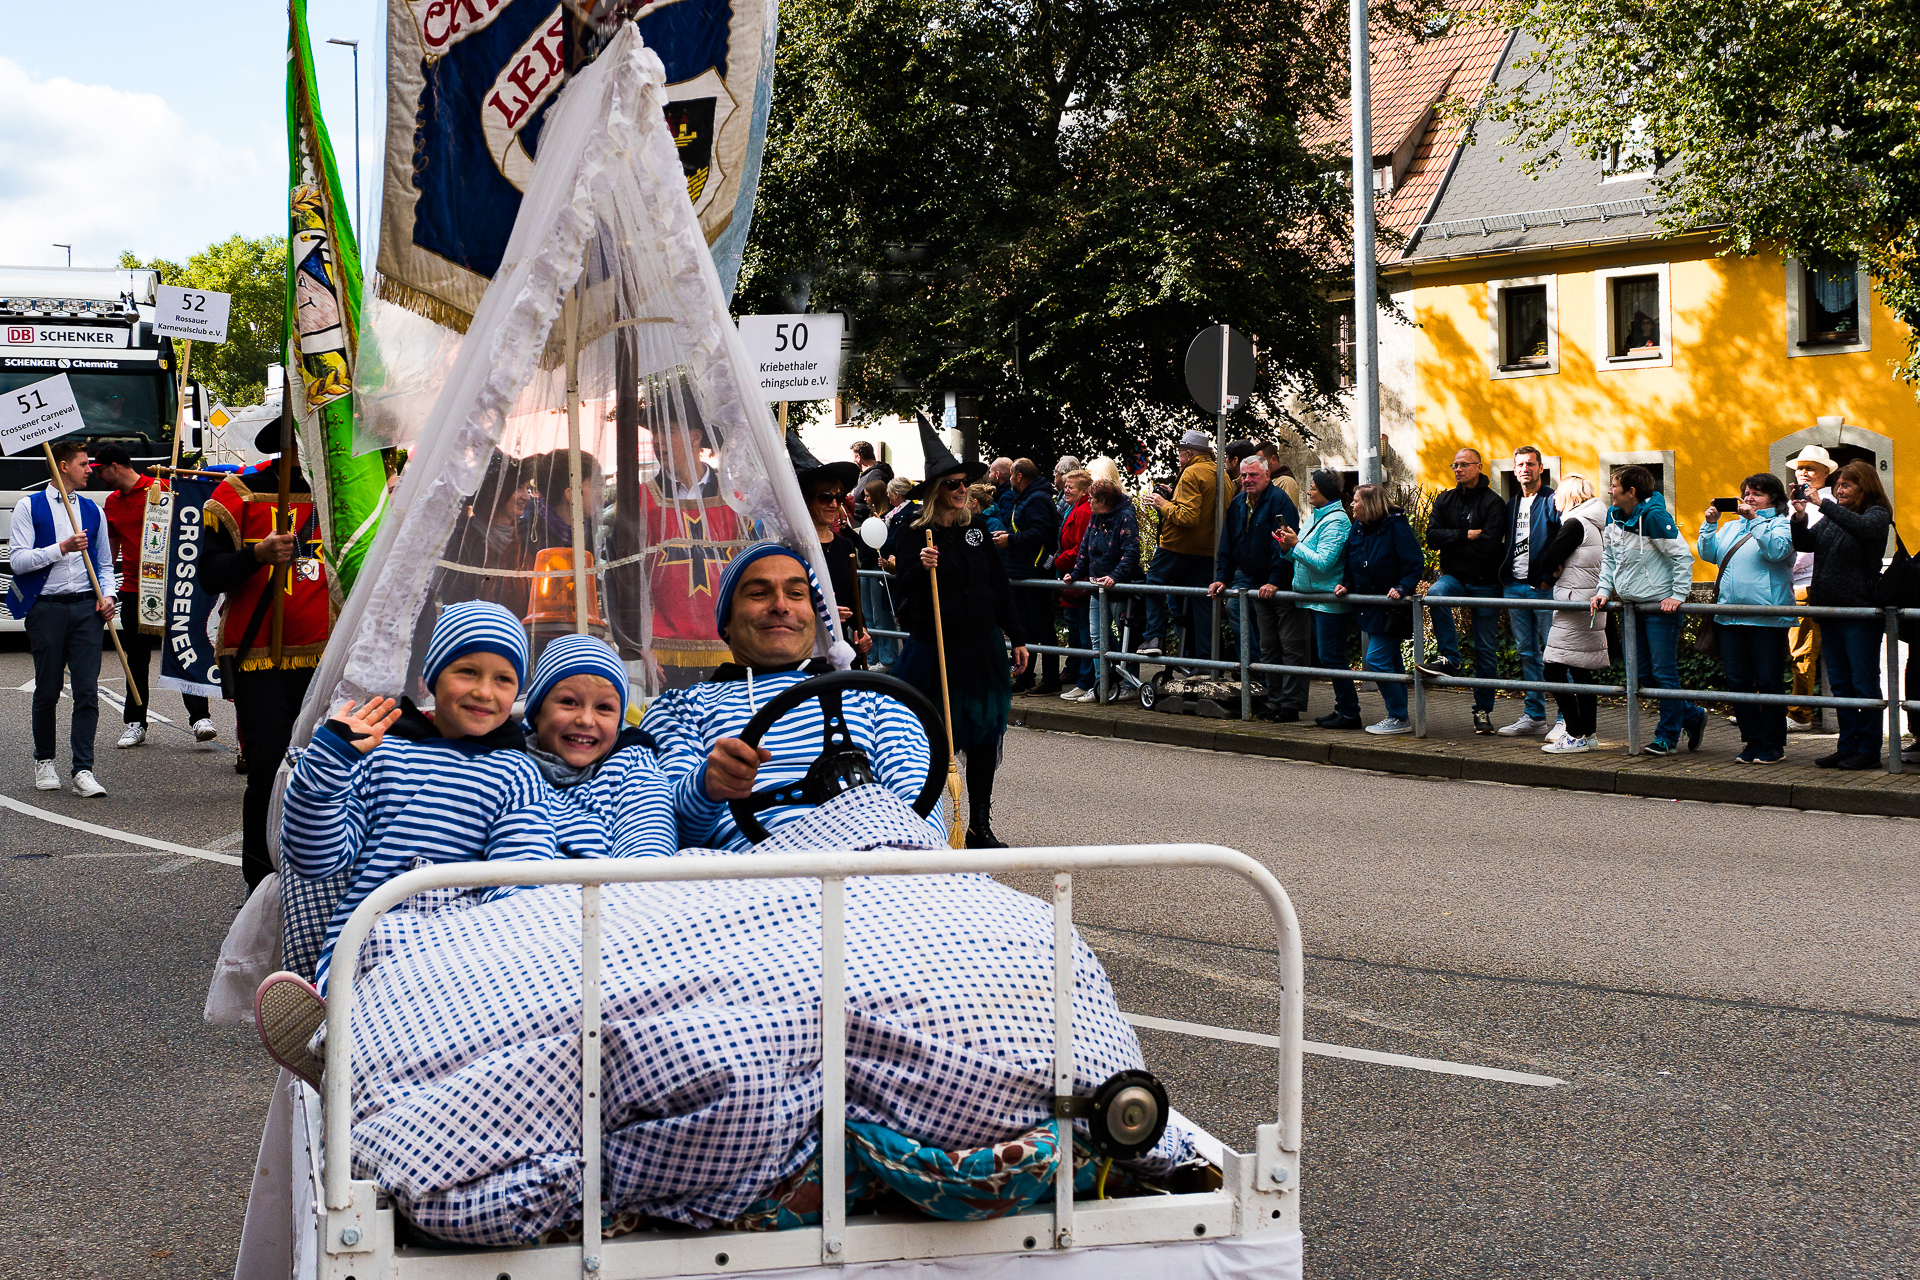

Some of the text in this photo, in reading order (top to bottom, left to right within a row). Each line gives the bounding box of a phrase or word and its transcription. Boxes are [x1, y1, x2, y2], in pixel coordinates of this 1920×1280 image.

[182, 293, 206, 312] 52
[175, 314, 208, 325] Rossauer
[10, 329, 115, 343] DB SCHENKER
[157, 323, 223, 337] Karnevalsclub e.V.
[774, 322, 809, 352] 50
[4, 358, 119, 369] SCHENKER Chemnitz
[759, 360, 818, 373] Kriebethaler
[811, 376, 829, 386] e.V.
[16, 389, 49, 415] 51
[0, 403, 76, 437] Crossener Carneval
[19, 421, 64, 442] Verein e.V.
[1880, 459, 1888, 471] 8
[171, 505, 201, 670] CROSSENER
